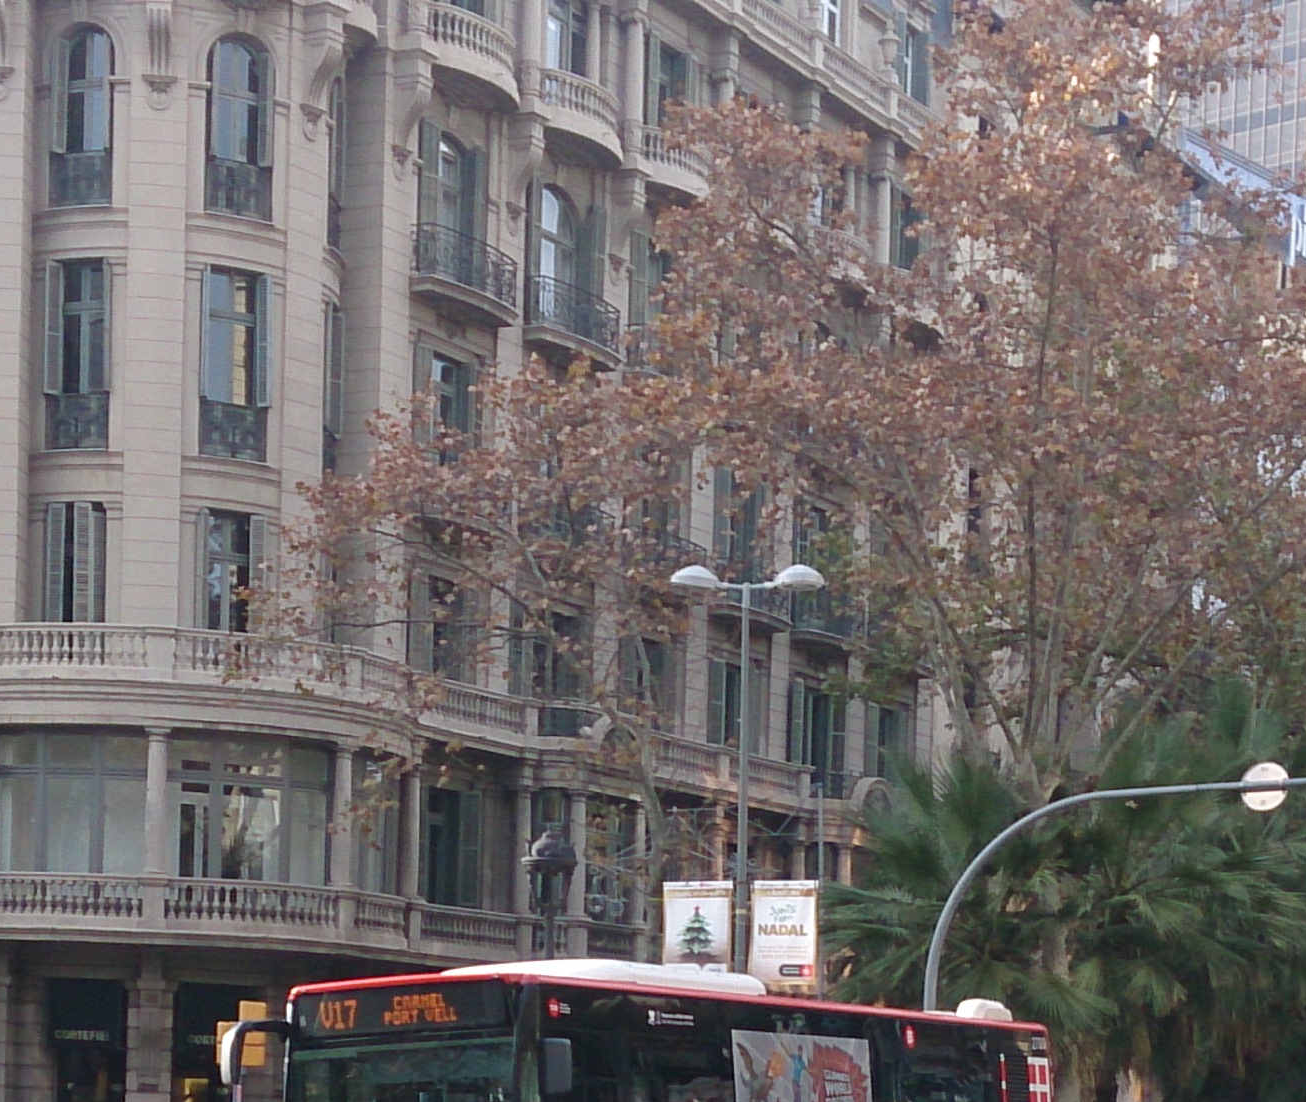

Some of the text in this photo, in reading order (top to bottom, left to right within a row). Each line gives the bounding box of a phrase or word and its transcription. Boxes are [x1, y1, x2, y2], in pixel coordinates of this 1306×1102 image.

[758, 924, 808, 937] NADAL
[384, 1006, 457, 1026] PORT VELL
[824, 1080, 853, 1096] WORLD
